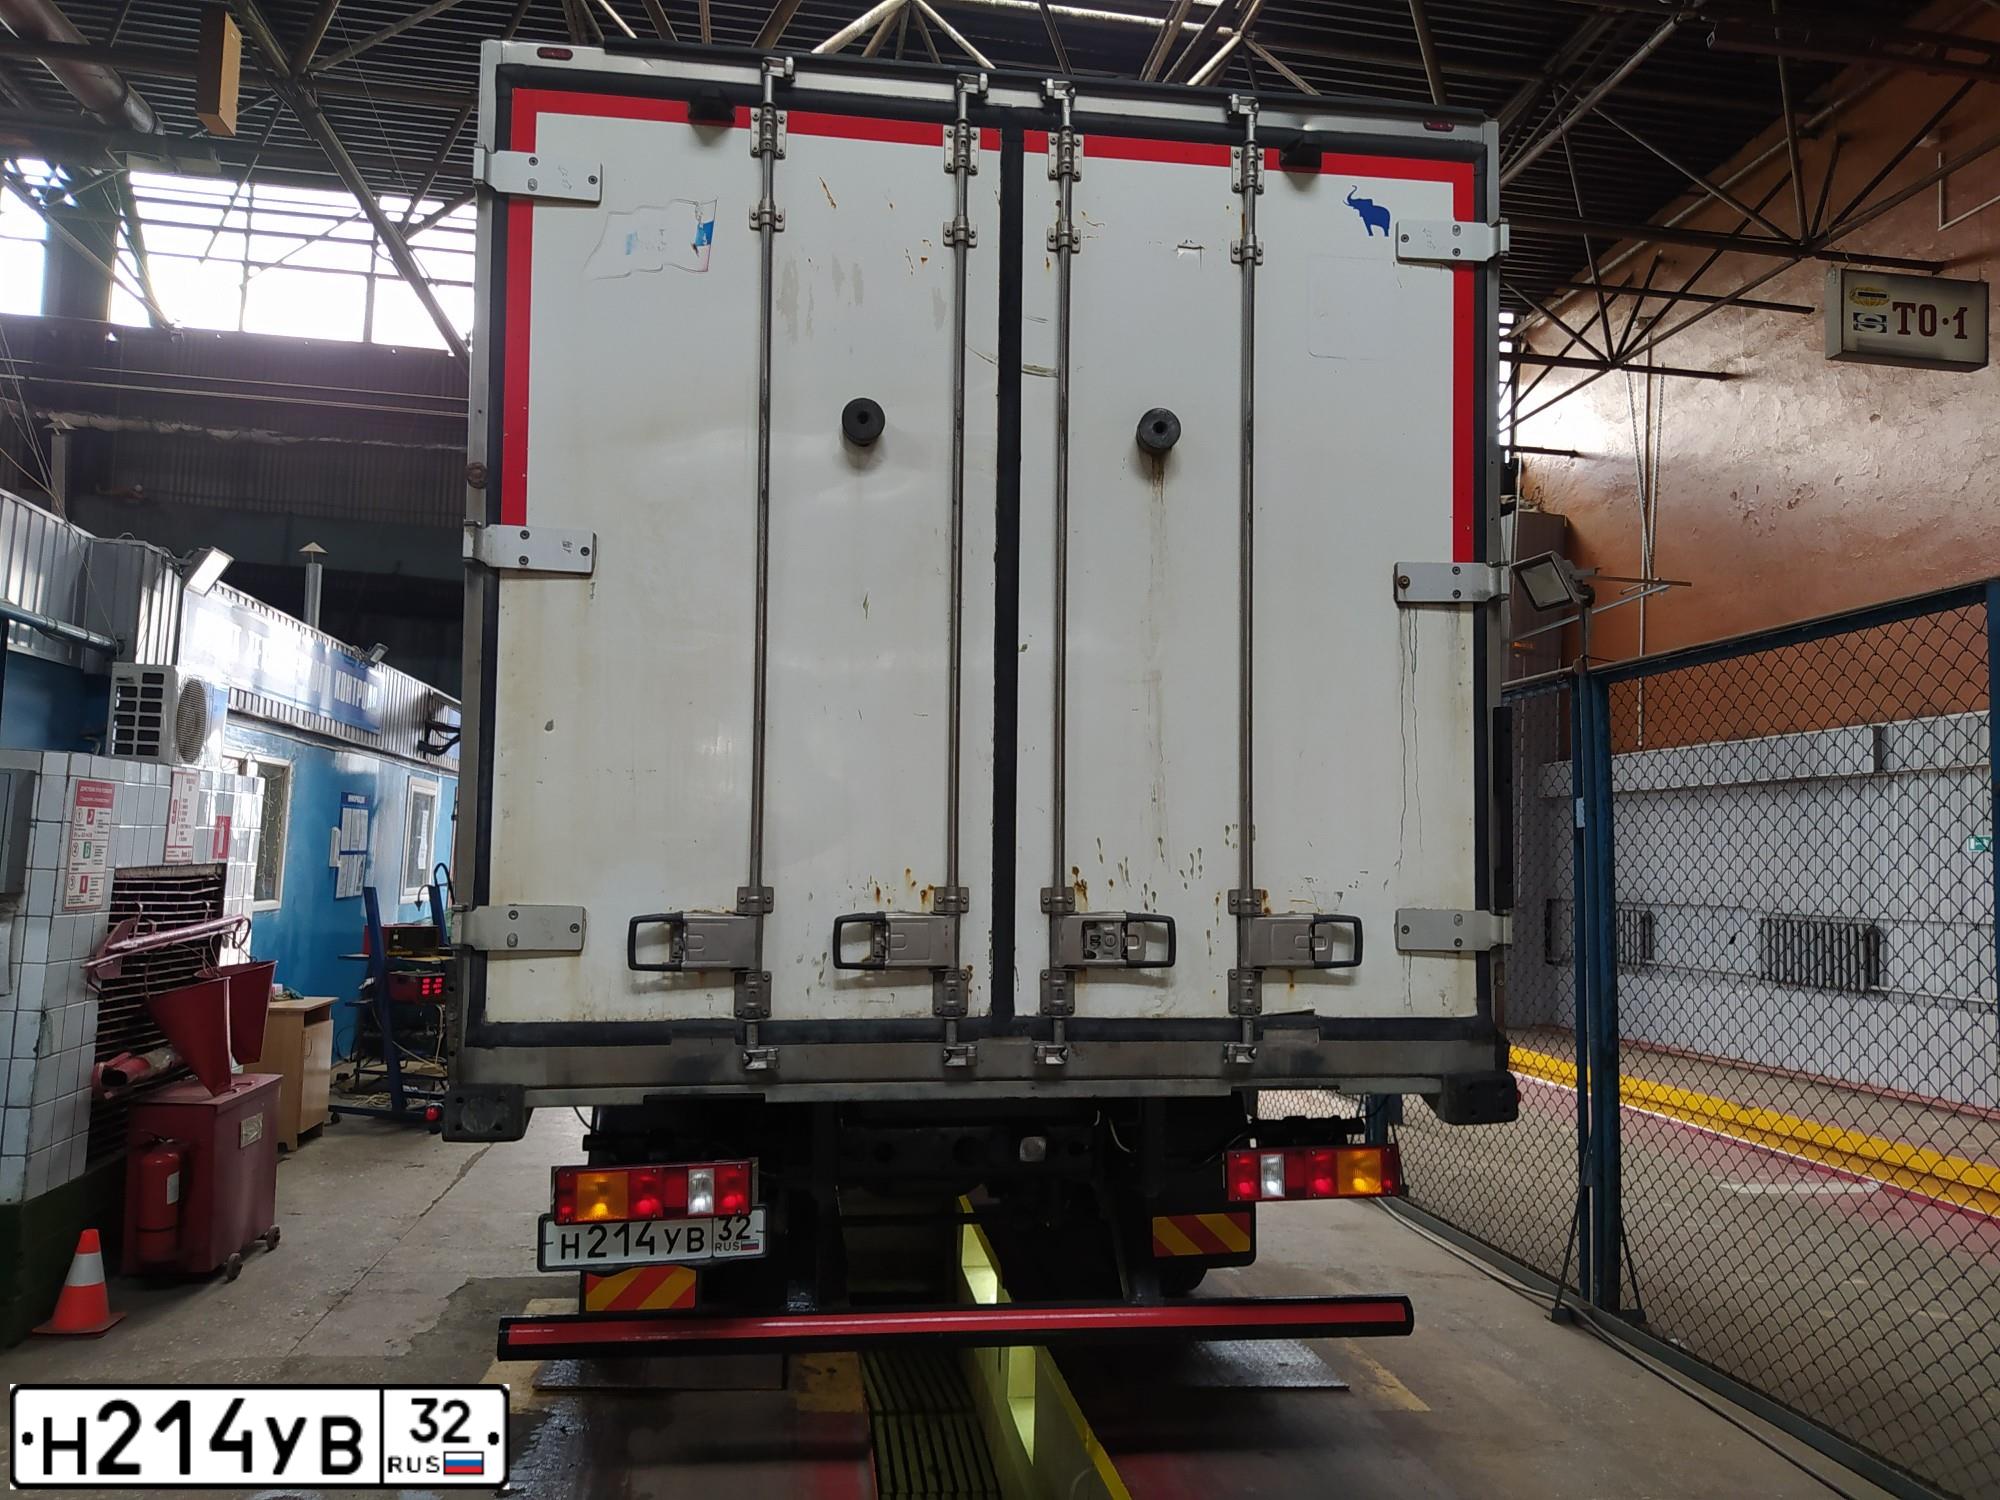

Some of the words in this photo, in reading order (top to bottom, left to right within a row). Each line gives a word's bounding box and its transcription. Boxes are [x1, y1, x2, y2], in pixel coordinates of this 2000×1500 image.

[560, 1223, 705, 1260] Н214УВ
[718, 1216, 751, 1241] 32
[715, 1241, 740, 1252] RUS
